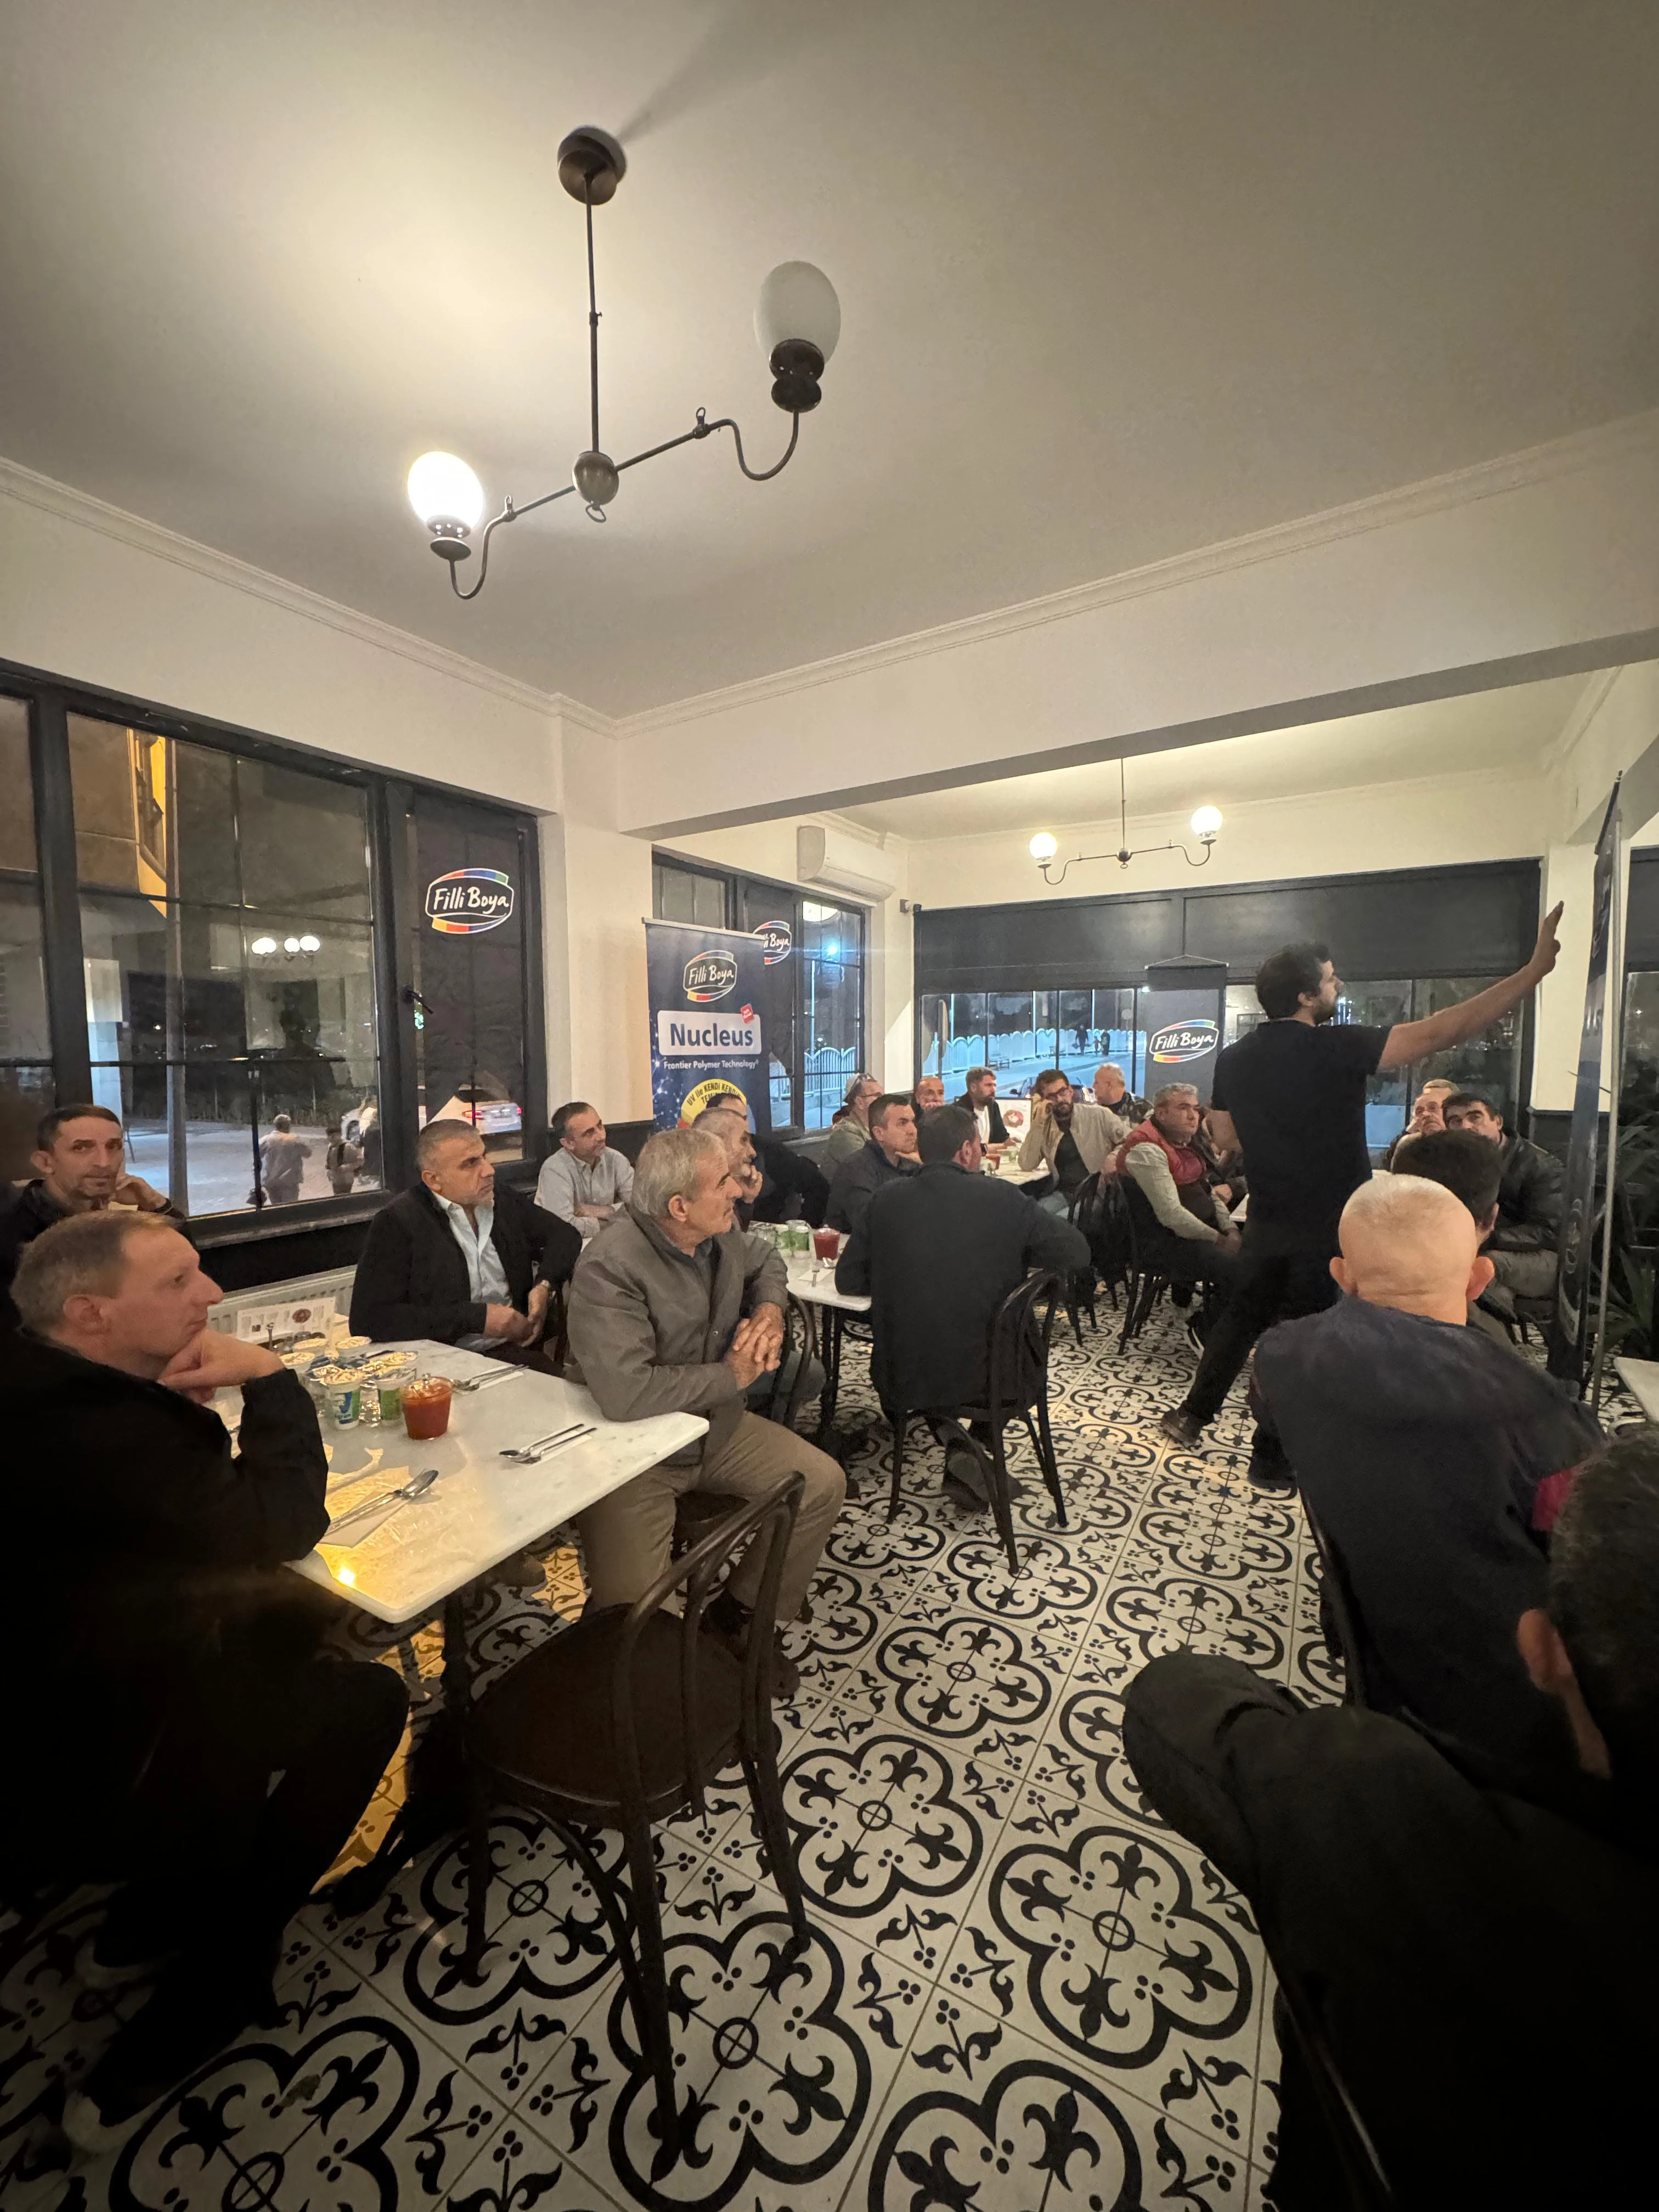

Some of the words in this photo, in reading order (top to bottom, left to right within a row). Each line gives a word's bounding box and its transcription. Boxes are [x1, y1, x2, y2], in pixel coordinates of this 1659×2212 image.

[433, 887, 465, 910] Filli
[467, 887, 509, 914] Boya
[770, 933, 790, 952] Boya
[689, 966, 707, 985] Filli
[709, 965, 734, 985] Boya
[670, 1023, 753, 1046] Nucleus
[1155, 1034, 1180, 1050] Filli
[1180, 1032, 1214, 1049] Boya
[664, 1060, 692, 1069] Frontier
[693, 1060, 720, 1070] Polymer
[687, 1094, 696, 1105] UV
